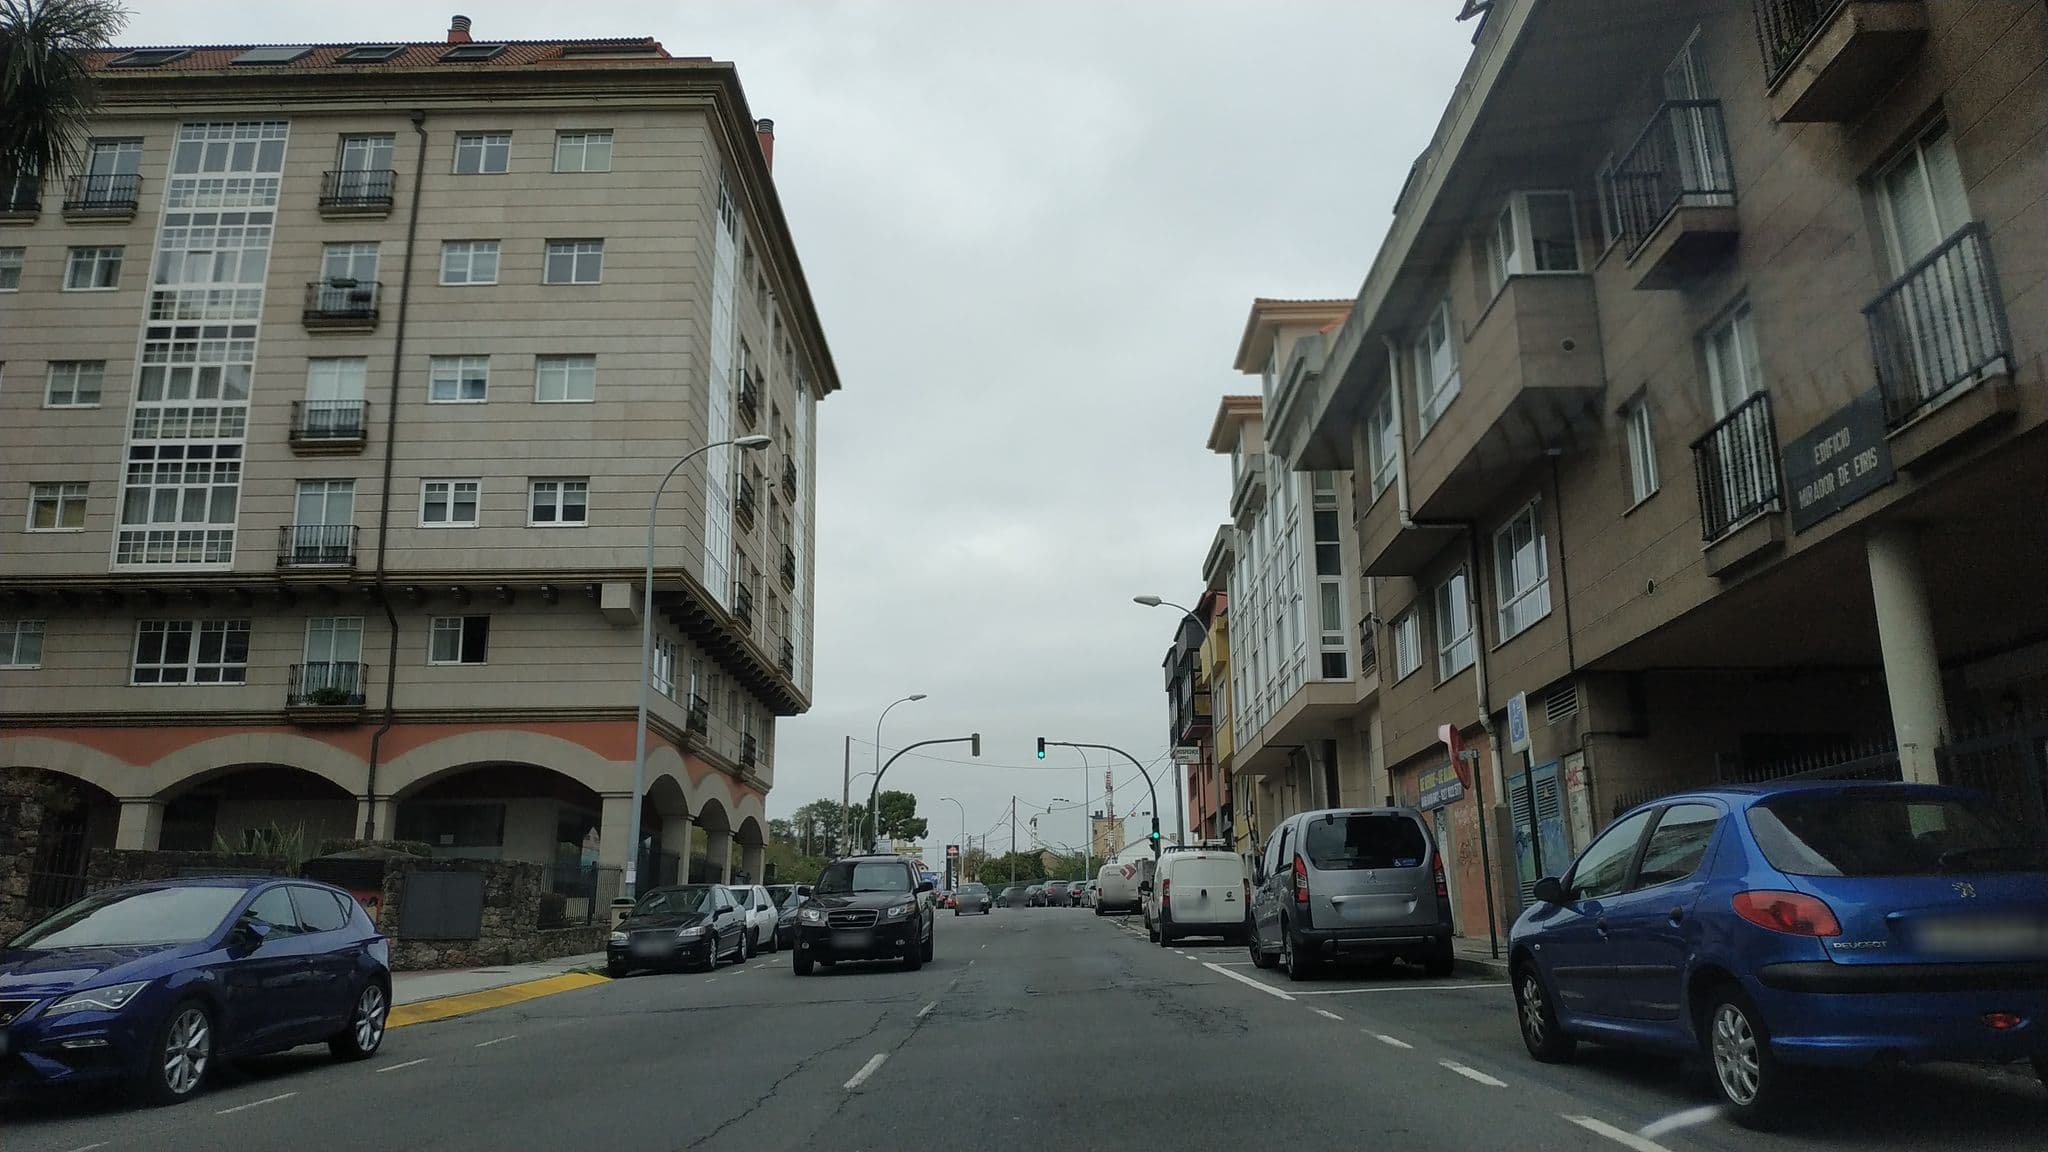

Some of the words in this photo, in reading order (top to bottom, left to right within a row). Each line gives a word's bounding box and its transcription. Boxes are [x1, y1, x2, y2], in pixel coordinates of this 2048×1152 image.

[1814, 427, 1850, 465] EDIFICIO
[1798, 472, 1835, 510] MIRADOR
[1838, 462, 1850, 487] DE
[1833, 941, 1887, 949] PEUGEOT
